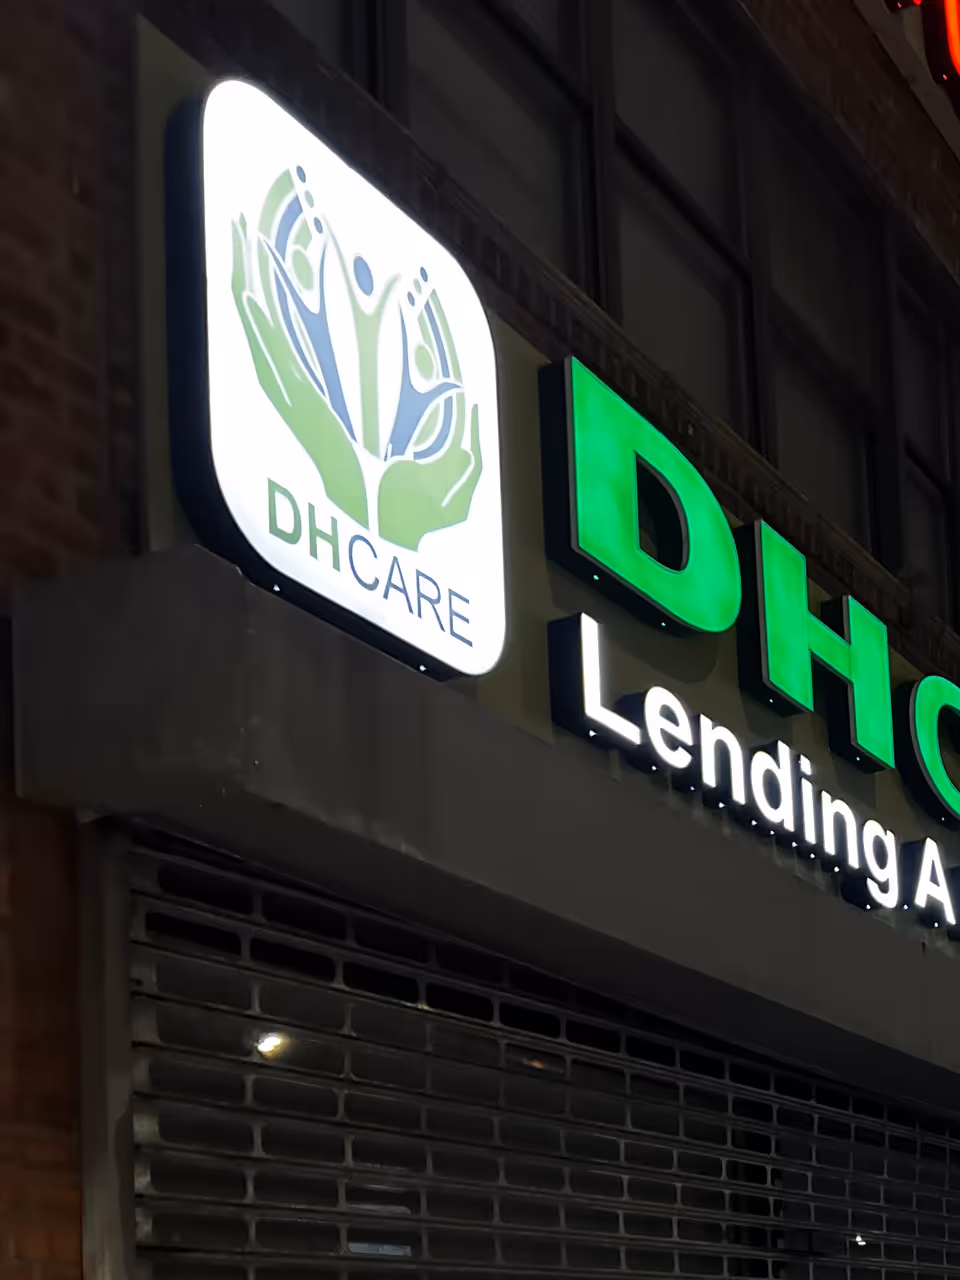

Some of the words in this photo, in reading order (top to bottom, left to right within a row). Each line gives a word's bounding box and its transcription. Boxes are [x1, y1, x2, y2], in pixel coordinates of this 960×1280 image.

[268, 477, 473, 648] DHCARE
[580, 611, 900, 909] Lending
[914, 836, 957, 925] A
